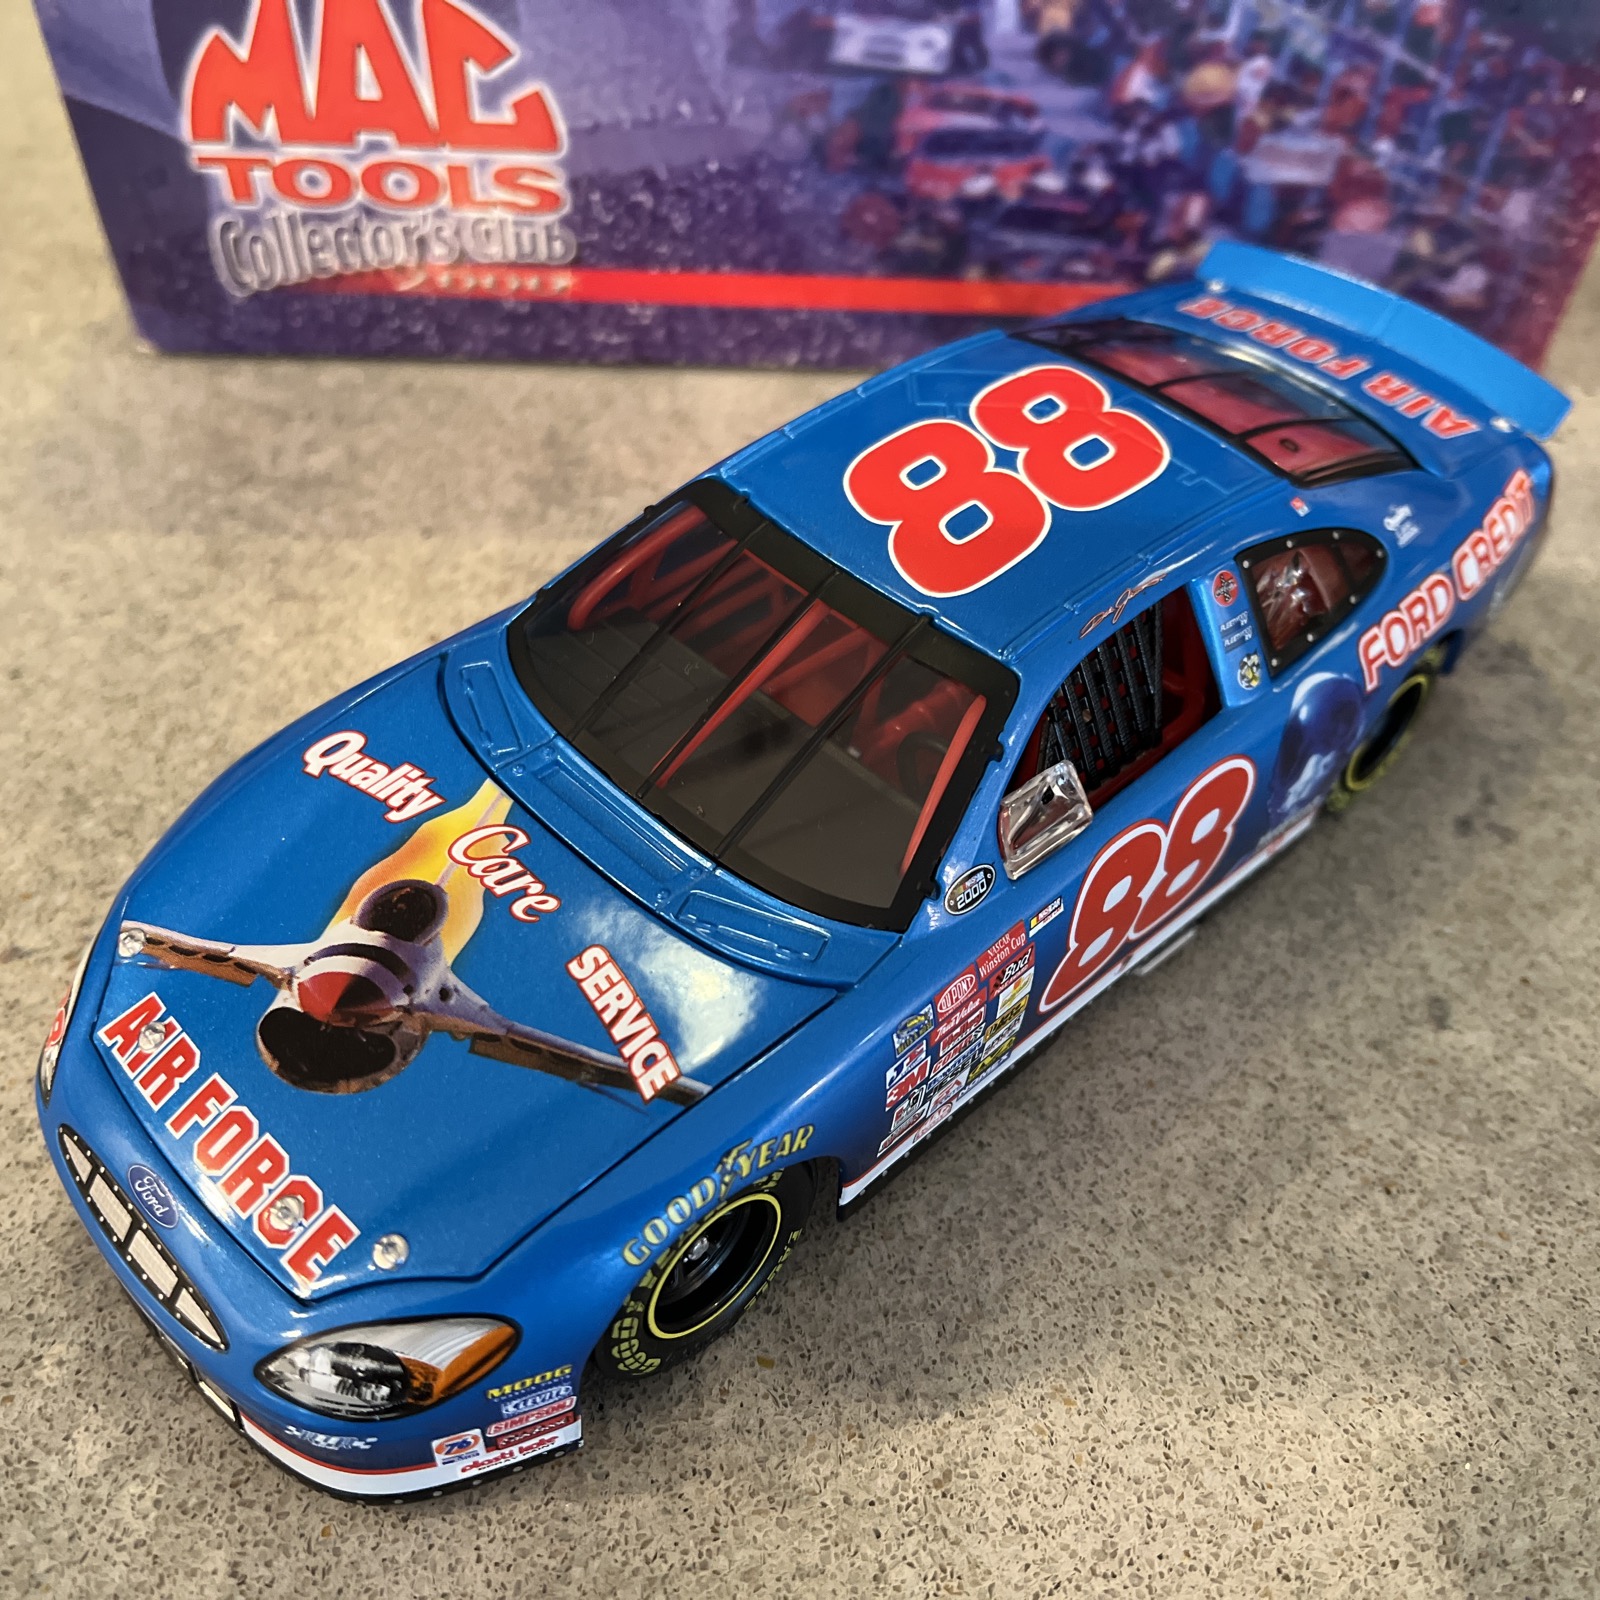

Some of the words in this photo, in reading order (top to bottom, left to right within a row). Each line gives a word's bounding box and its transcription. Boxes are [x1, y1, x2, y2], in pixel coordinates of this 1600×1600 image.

[184, 0, 567, 156] MAC
[190, 153, 571, 216] TOOLS
[1175, 296, 1371, 380] FORCE
[1361, 371, 1480, 439] AIR
[843, 365, 1170, 598] 88
[1359, 572, 1455, 694] FORD
[1452, 467, 1536, 601] CREDIT
[302, 730, 446, 823] Quality
[448, 824, 561, 923] Care
[956, 879, 987, 910] 2000
[1036, 754, 1256, 1014] 88
[979, 946, 1010, 979] Winston
[1010, 931, 1026, 951] Cup
[987, 933, 1011, 959] NASCAR
[1001, 947, 1032, 984] Bud
[565, 943, 682, 1105] SERVICE
[886, 1060, 929, 1111] 3M
[97, 991, 201, 1113] AIR
[164, 1072, 361, 1292] FORCE
[134, 1174, 169, 1219] Ford
[622, 1124, 815, 1266] GOODYEAR
[487, 1364, 572, 1400] MOOG
[444, 1437, 473, 1456] 76
[491, 1398, 573, 1435] SIMPSON
